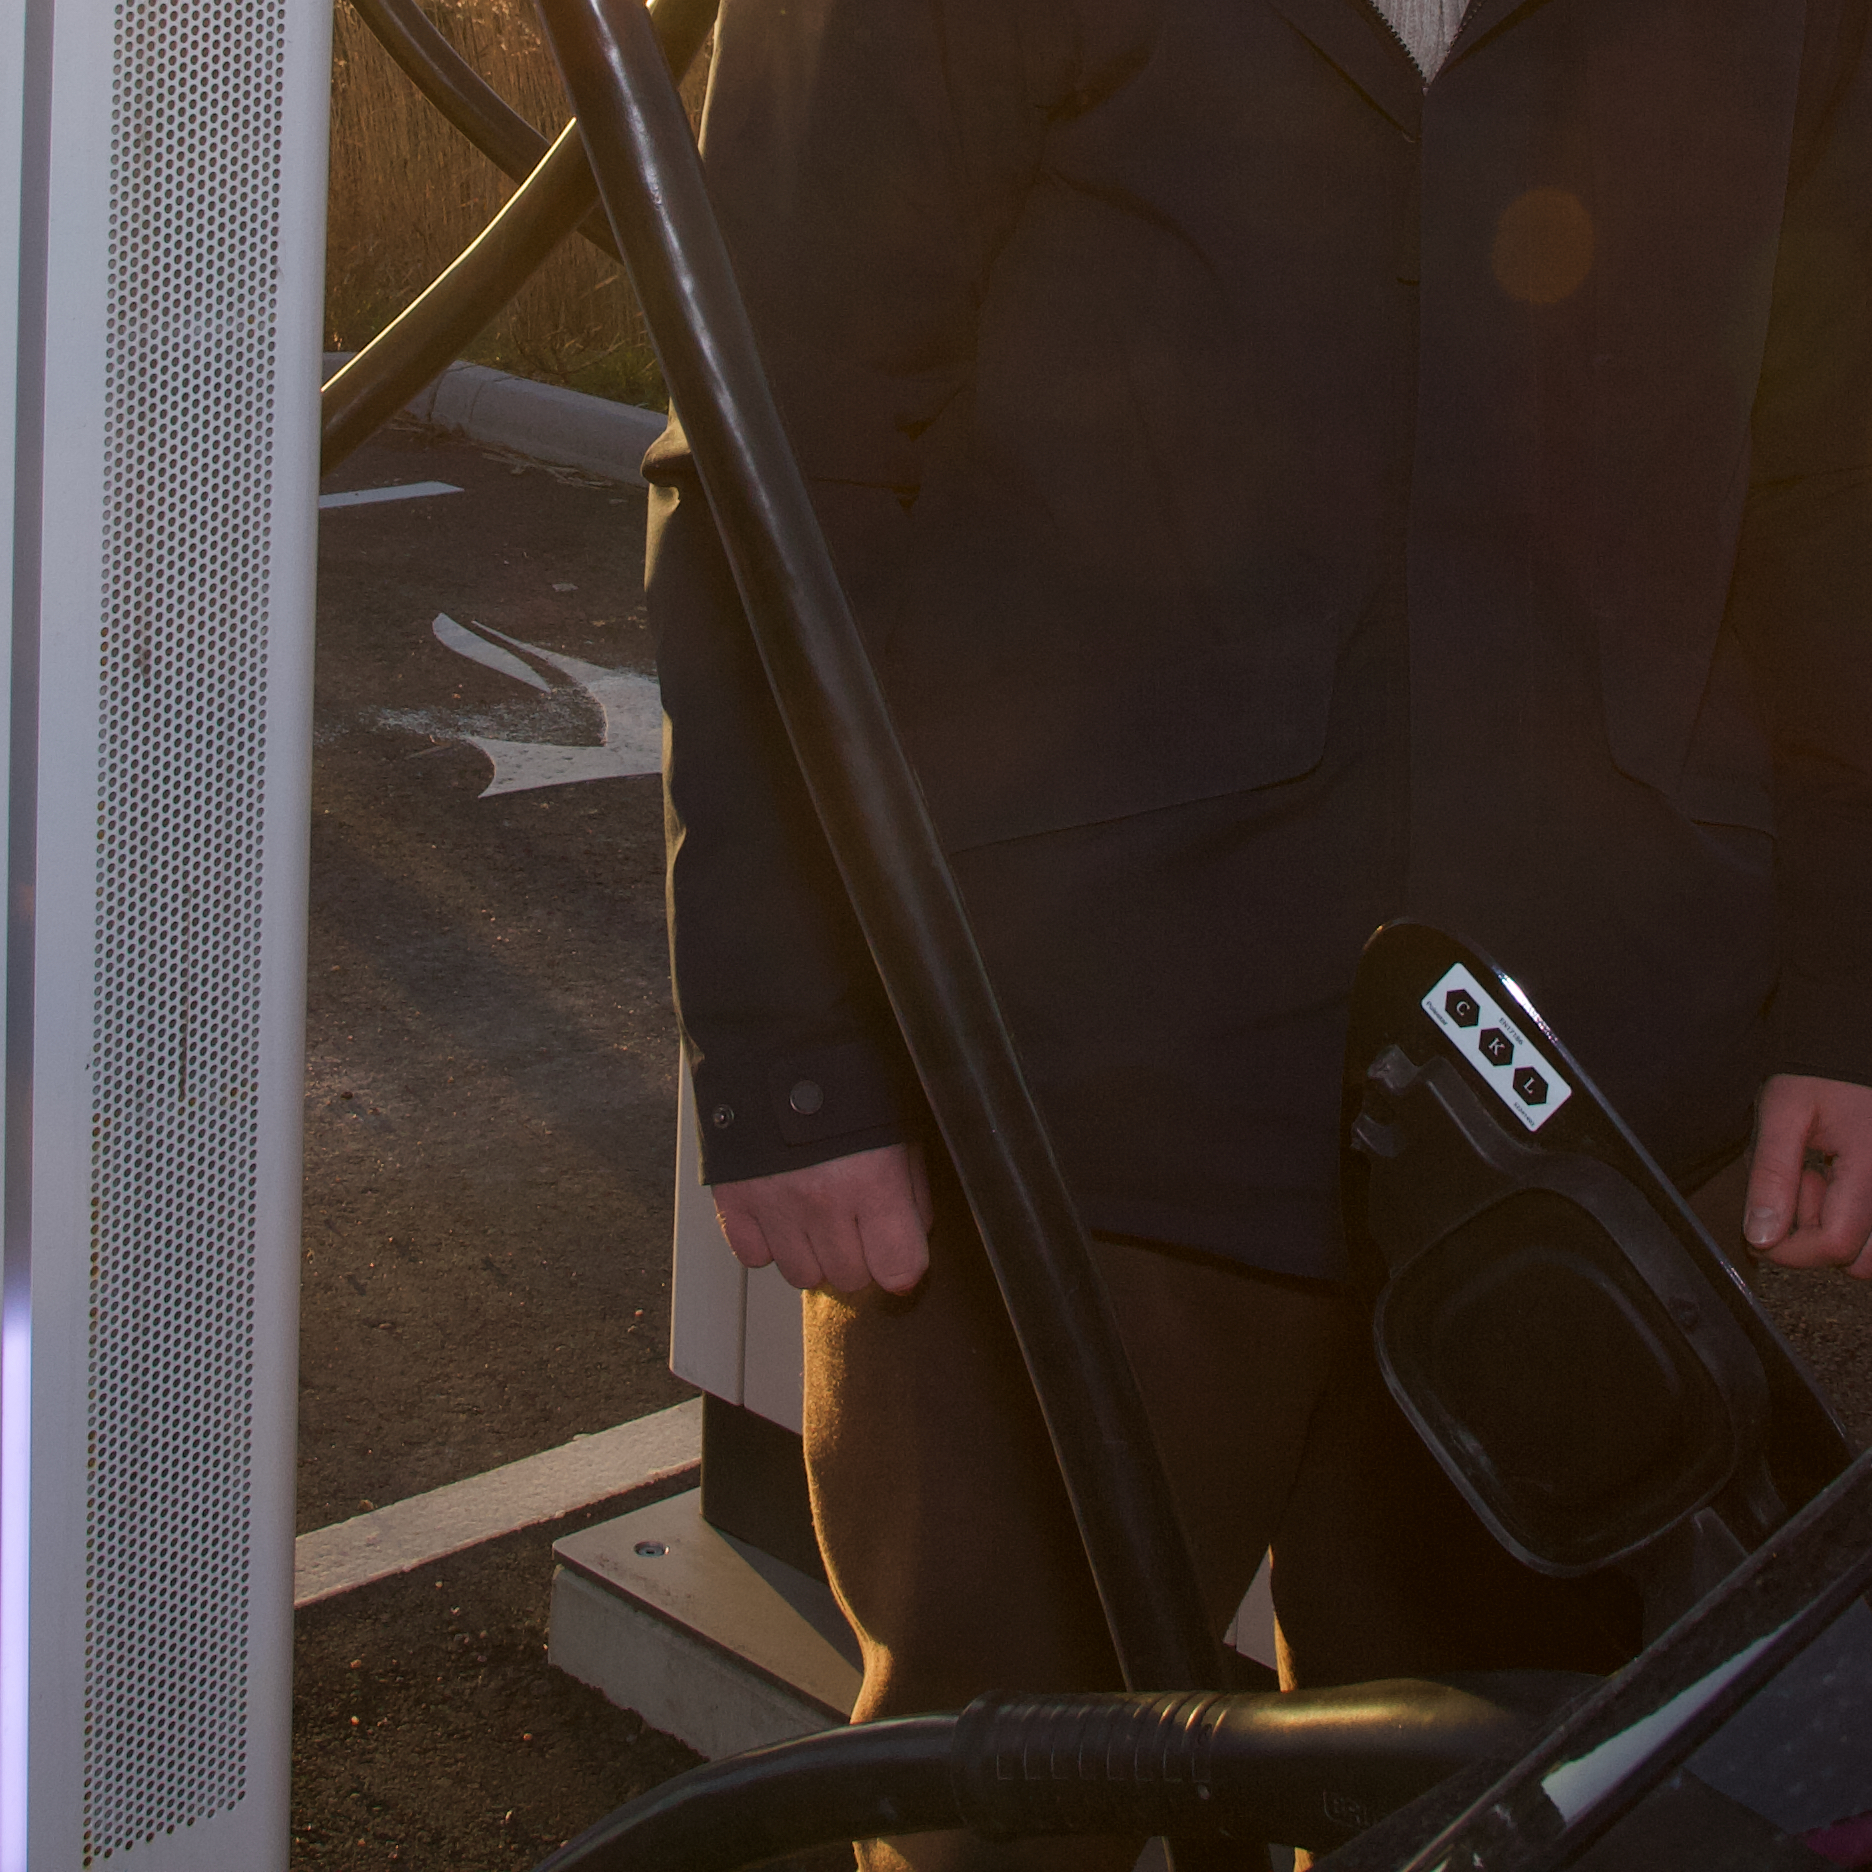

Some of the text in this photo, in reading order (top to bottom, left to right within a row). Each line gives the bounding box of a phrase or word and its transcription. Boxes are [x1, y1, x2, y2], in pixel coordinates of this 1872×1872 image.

[1455, 1000, 1471, 1017] C
[1498, 1017, 1524, 1046] EN17186
[1487, 1037, 1506, 1057] K
[1522, 1076, 1536, 1096] L
